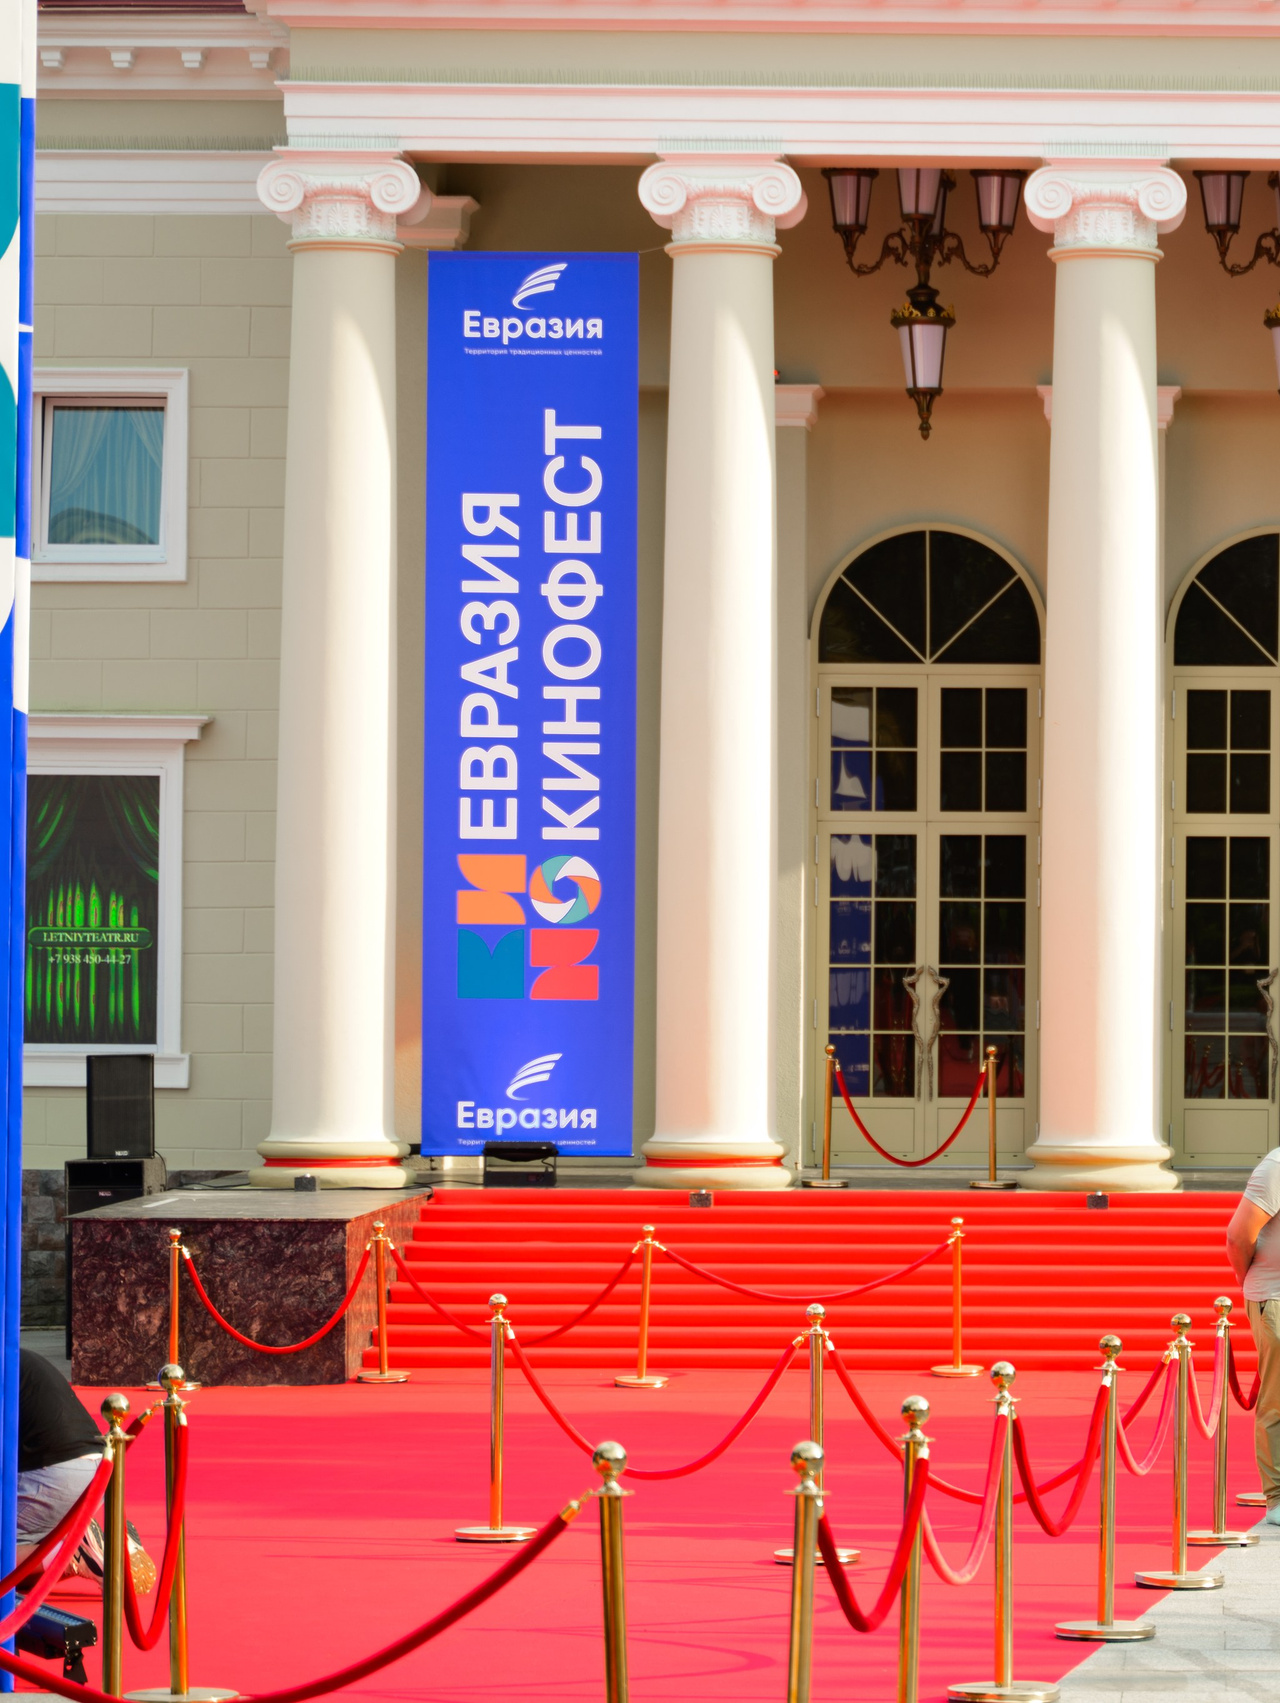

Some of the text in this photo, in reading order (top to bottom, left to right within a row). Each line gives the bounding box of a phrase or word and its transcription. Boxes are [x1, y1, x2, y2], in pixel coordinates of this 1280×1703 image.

[463, 310, 603, 345] Евразия
[464, 347, 602, 356] Территория традиционных ценностей
[541, 409, 603, 840] КИНОФЕСТ
[459, 493, 519, 839] ЕВРАЗИЯ
[43, 932, 139, 942] LETNIYTEATR.RU
[49, 953, 132, 964] +7 938 450-44-27
[457, 1101, 597, 1135] Евразия
